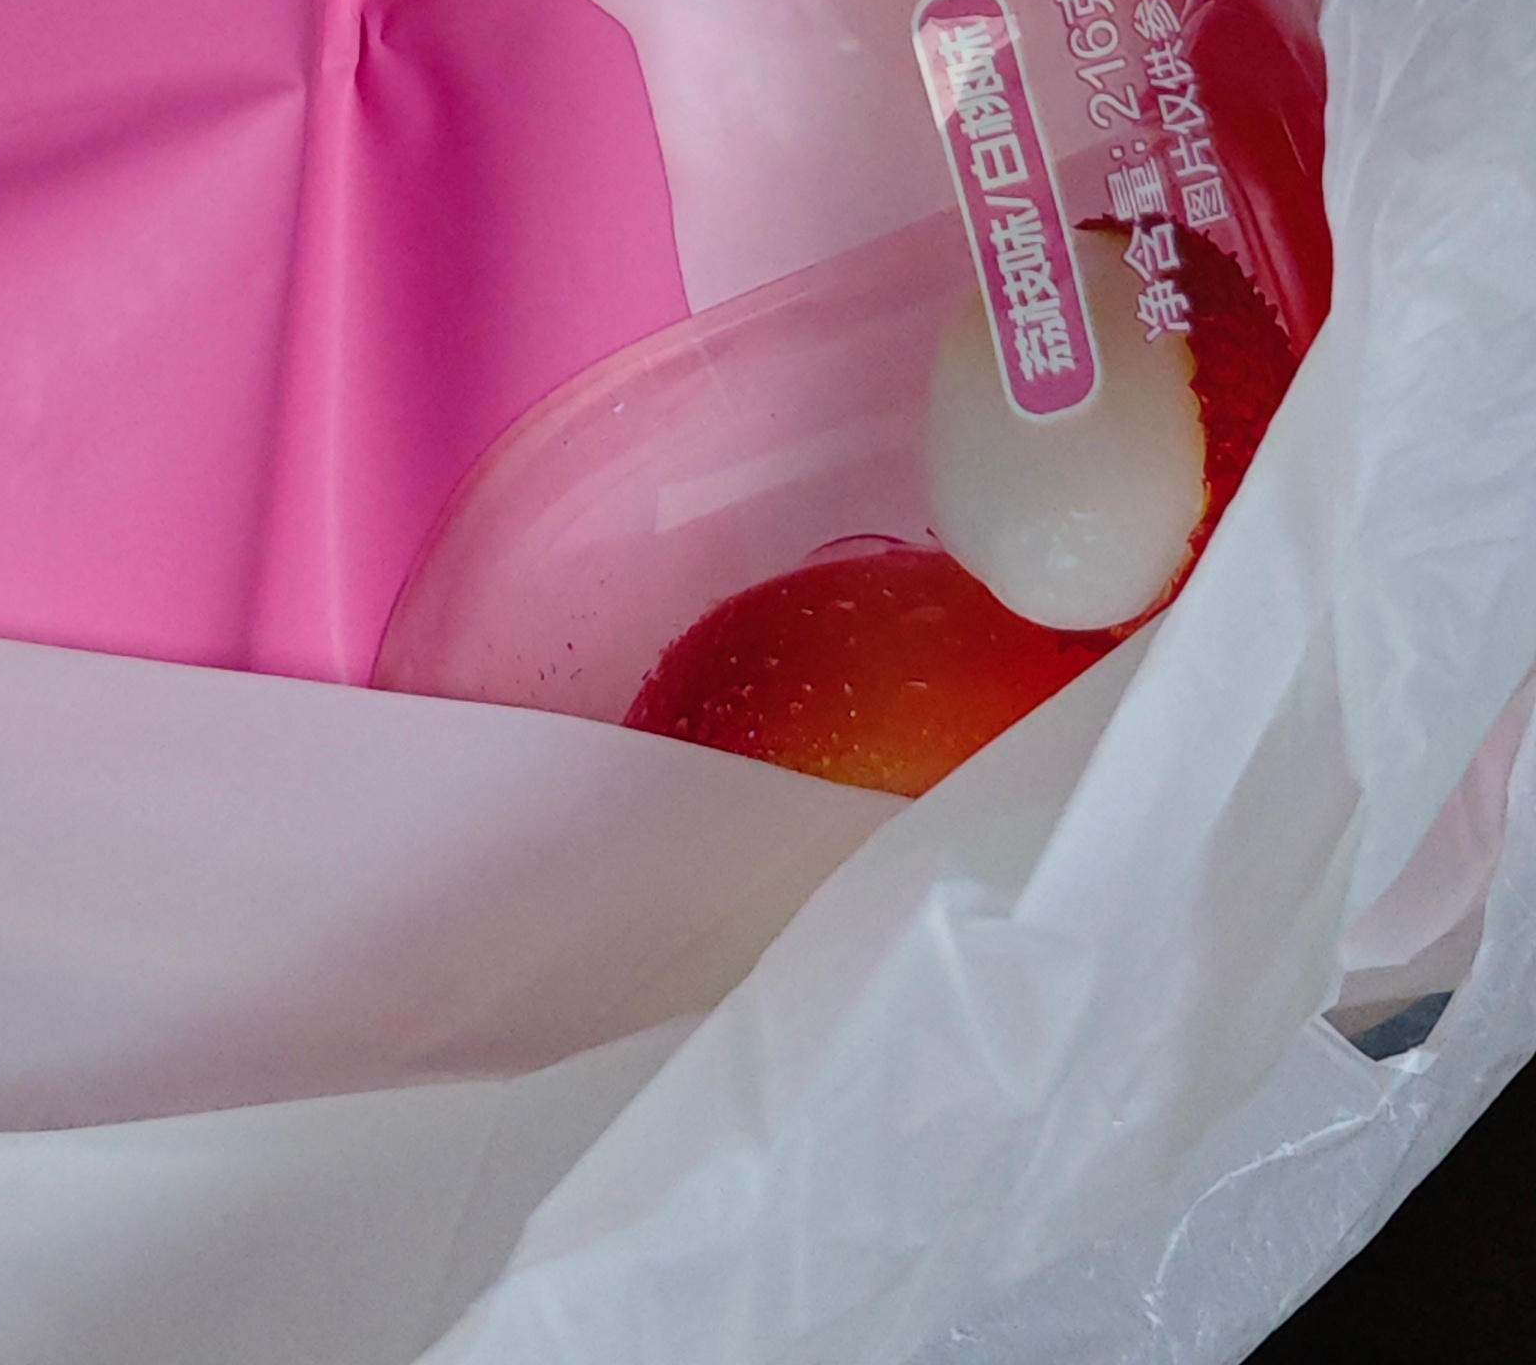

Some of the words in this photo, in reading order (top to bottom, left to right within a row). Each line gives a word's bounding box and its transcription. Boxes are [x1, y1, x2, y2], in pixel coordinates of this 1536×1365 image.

[937, 20, 1079, 383] 荔枝味/白桃味
